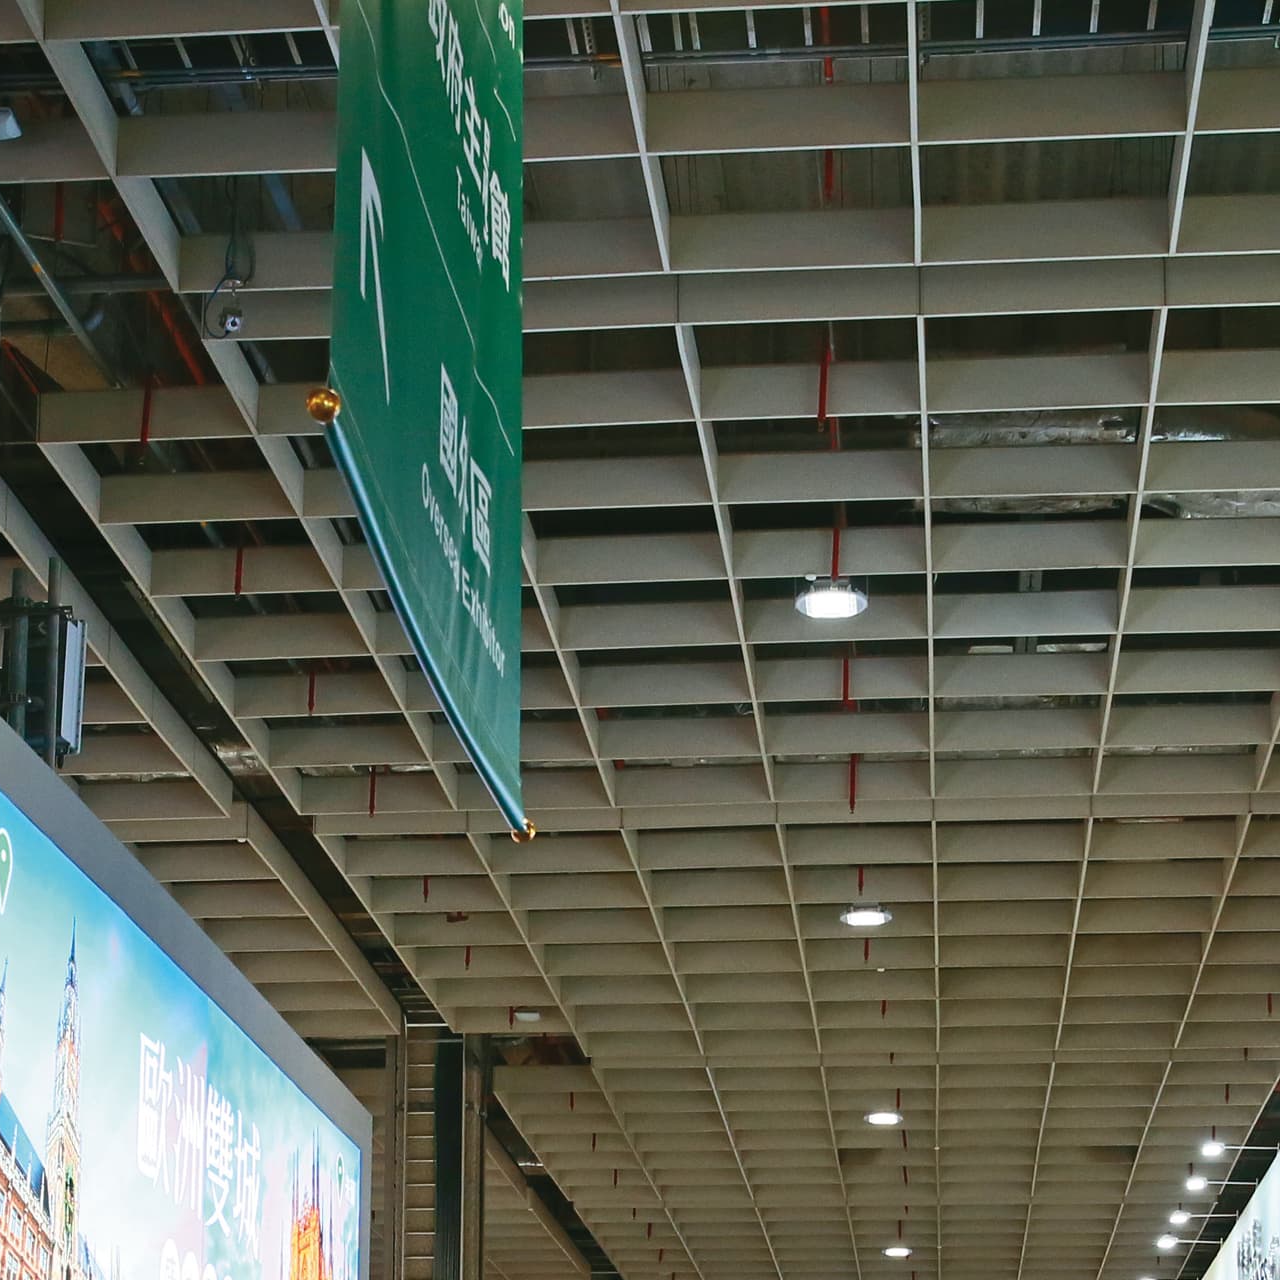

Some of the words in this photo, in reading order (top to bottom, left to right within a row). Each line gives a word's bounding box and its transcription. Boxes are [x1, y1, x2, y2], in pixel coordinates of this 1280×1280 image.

[461, 566, 506, 679] Exhibitor
[137, 1032, 261, 1261] 歐洲雙城
